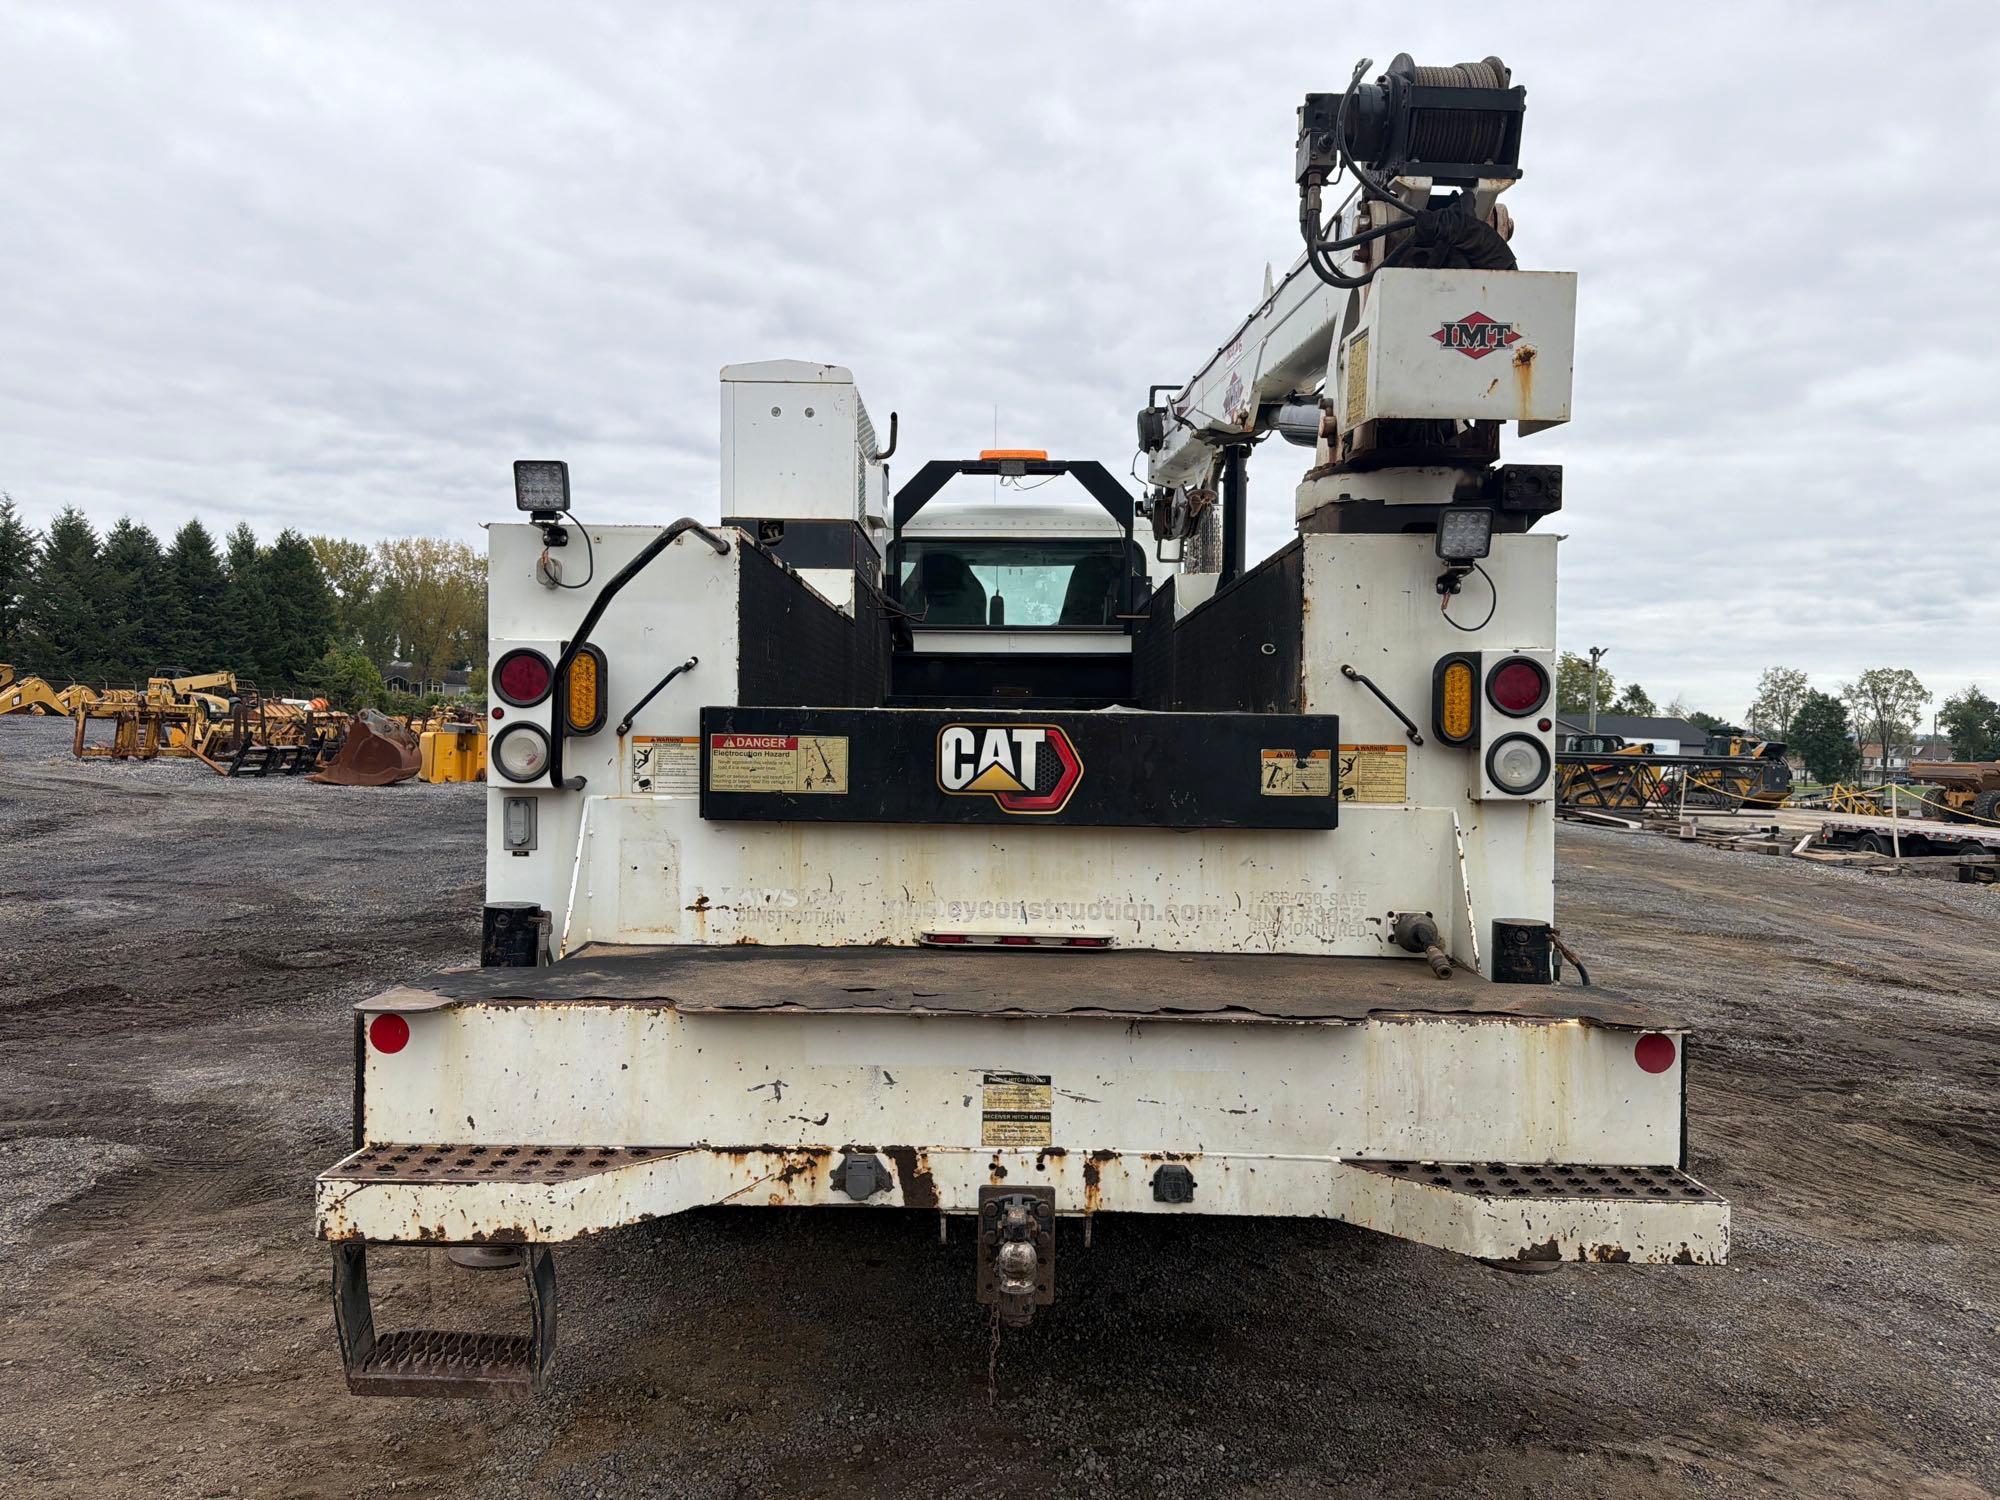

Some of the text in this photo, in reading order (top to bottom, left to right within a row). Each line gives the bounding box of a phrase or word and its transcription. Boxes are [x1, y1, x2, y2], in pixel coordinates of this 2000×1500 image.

[1441, 322, 1511, 348] IMT
[736, 737, 787, 748] DANGER
[713, 749, 790, 758] Electrocution Hazard
[941, 726, 1046, 792] CAT
[1248, 891, 1368, 907] 1-866-750-SAFE
[884, 897, 1221, 922] nsleyconstruction.com
